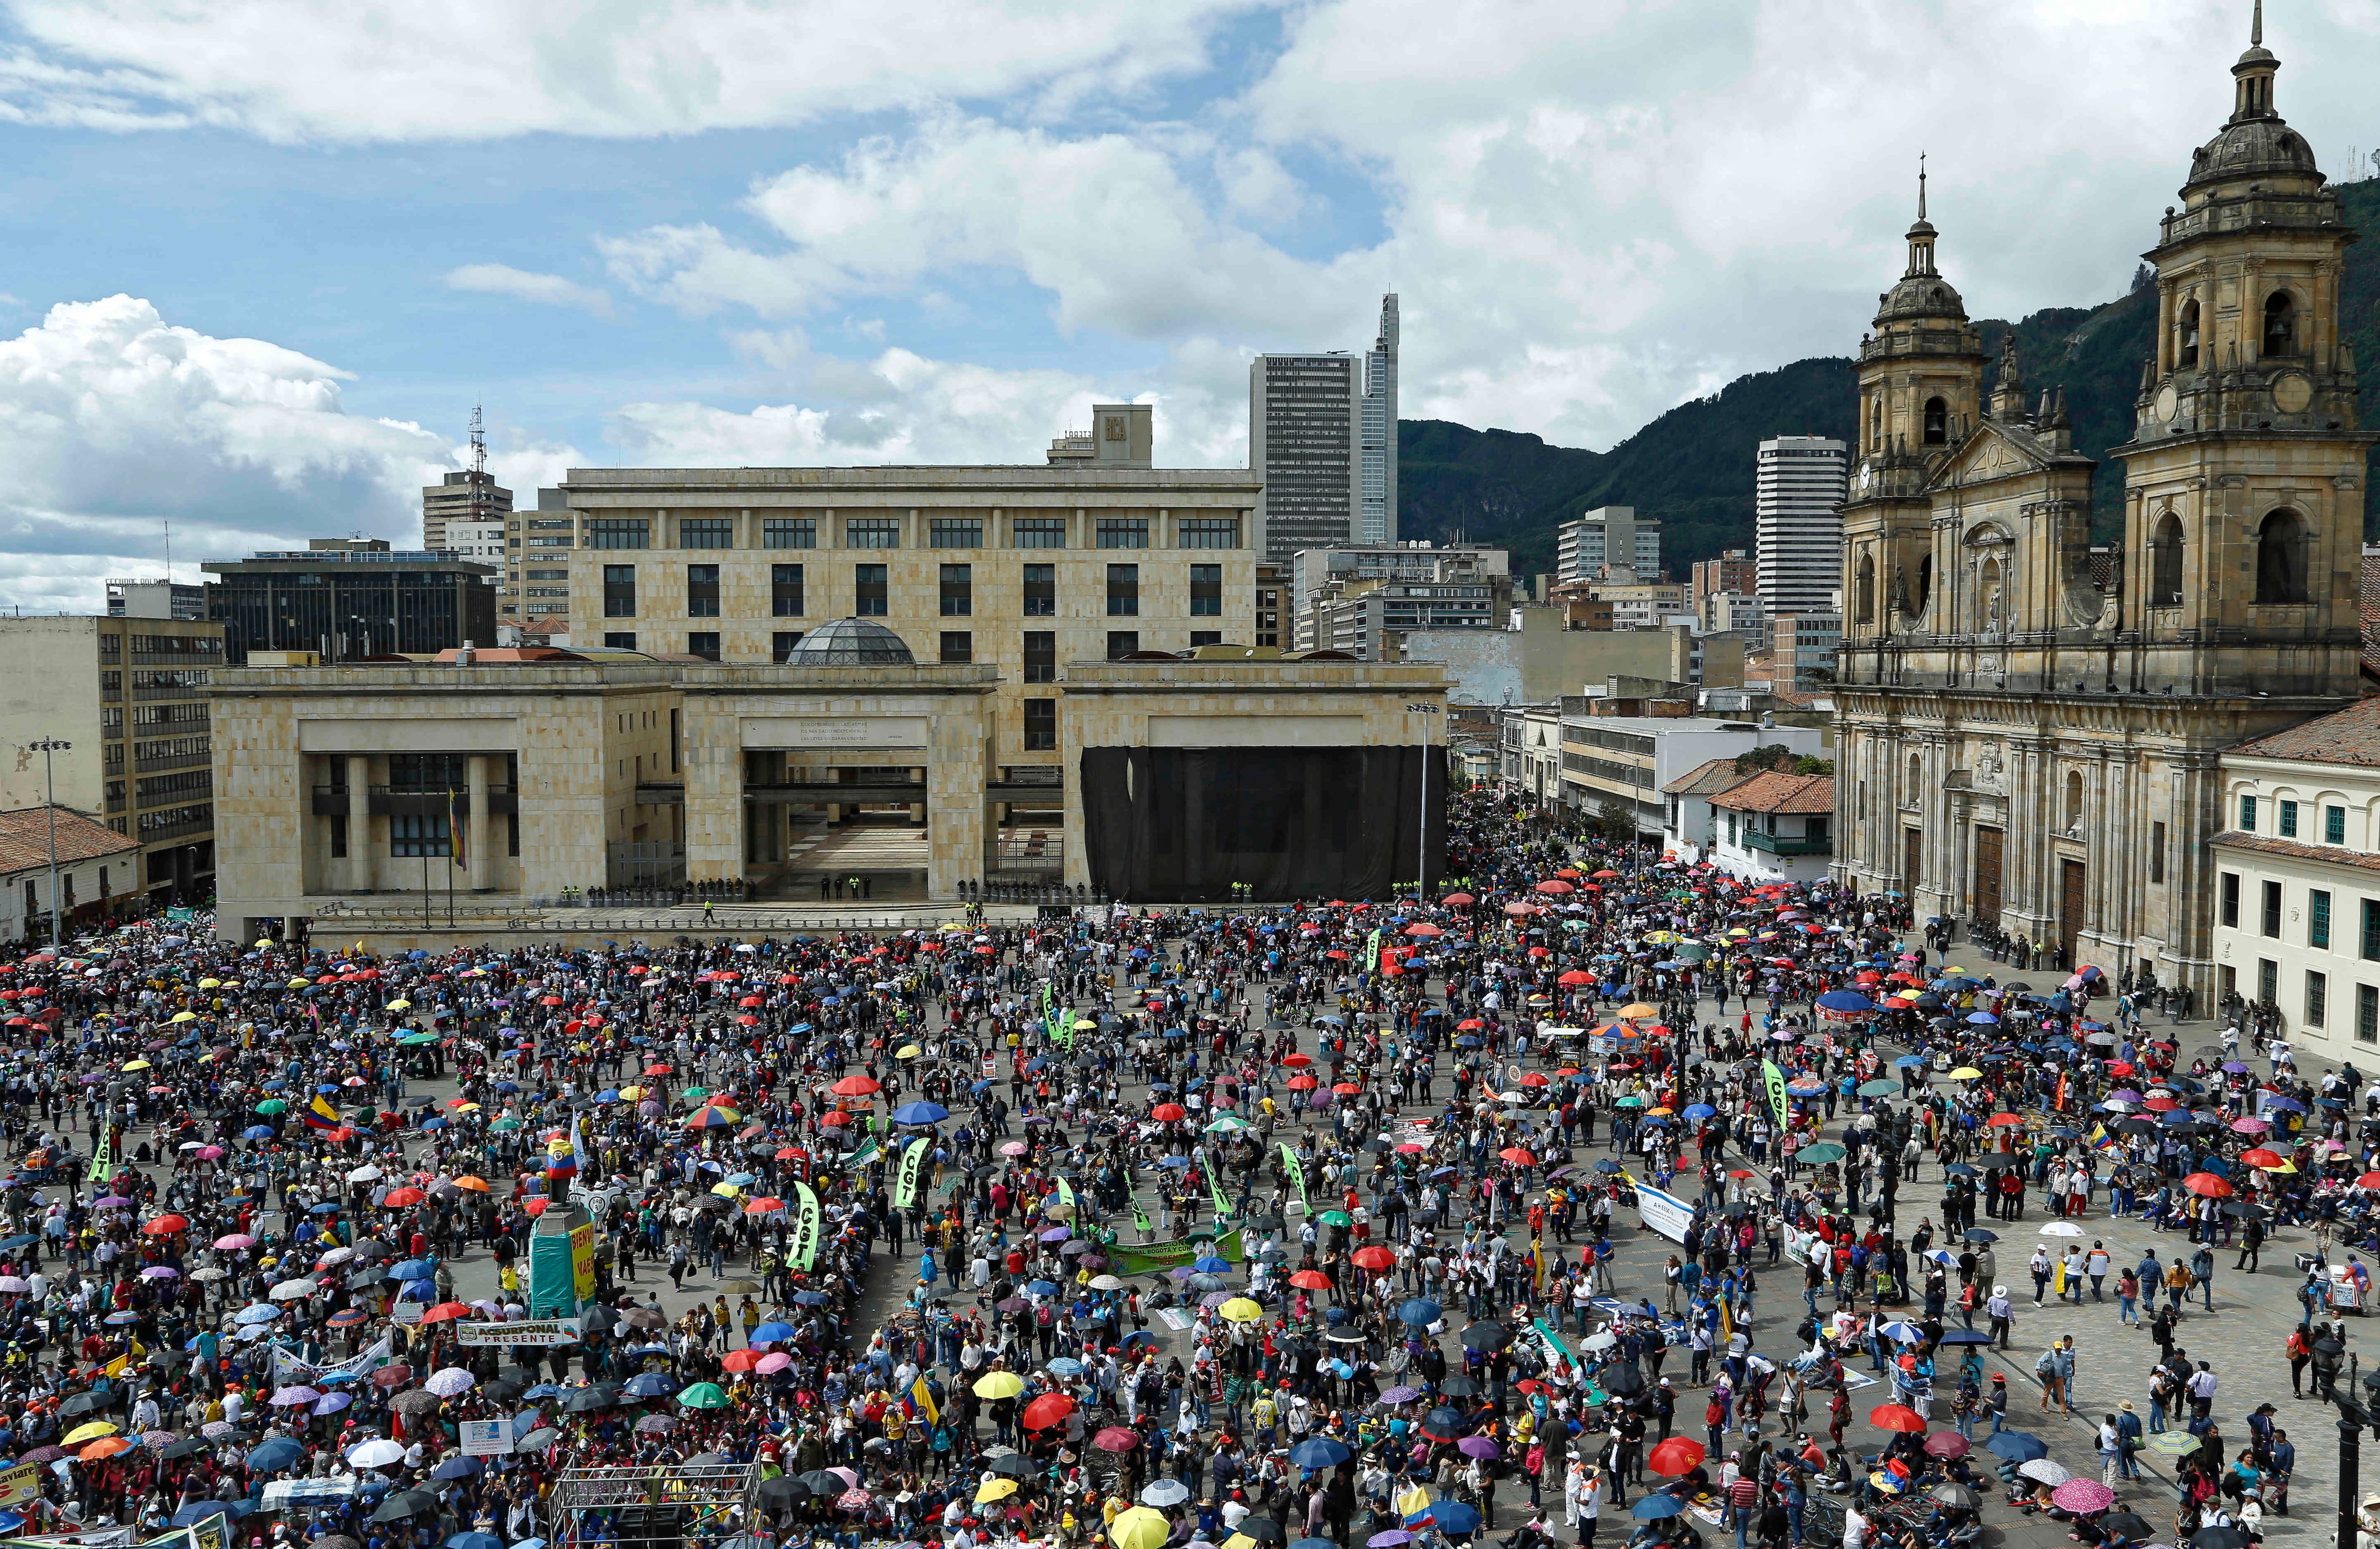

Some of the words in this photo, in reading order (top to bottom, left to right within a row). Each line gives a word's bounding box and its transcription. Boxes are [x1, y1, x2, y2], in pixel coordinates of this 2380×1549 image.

[1772, 1082, 1783, 1122] CGT
[98, 1132, 109, 1174] CGT
[903, 1155, 915, 1200] CGT
[796, 1207, 813, 1260] CGT
[477, 1324, 560, 1336] ACSURPONAL
[485, 1334, 555, 1343] PRESENTE
[0, 1466, 35, 1484] aviare
